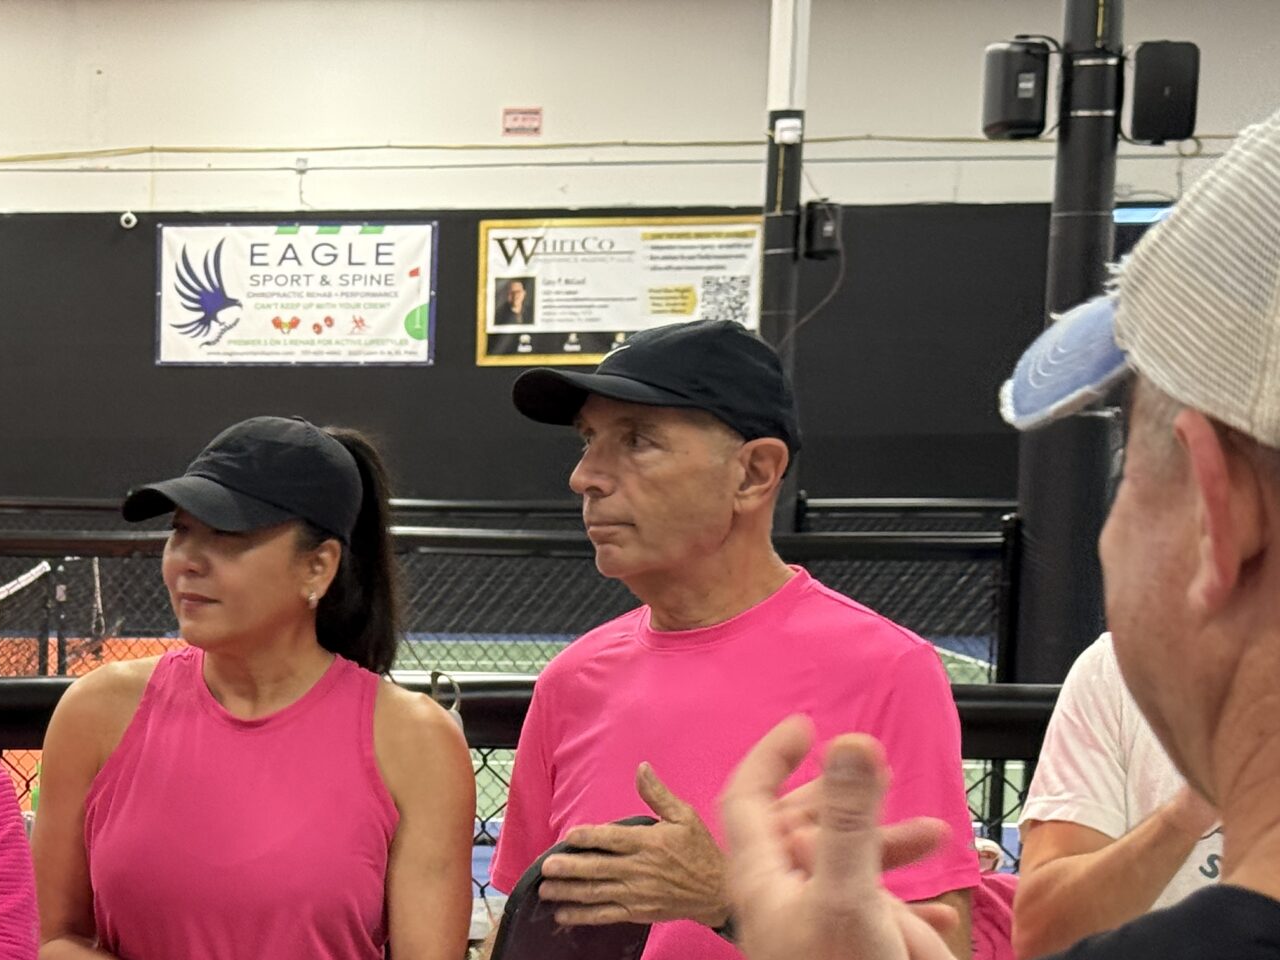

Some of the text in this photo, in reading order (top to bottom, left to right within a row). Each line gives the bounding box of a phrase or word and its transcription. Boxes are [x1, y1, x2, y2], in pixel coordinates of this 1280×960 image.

[250, 242, 395, 266] EAGLE
[249, 273, 395, 287] SPORT & SPINE
